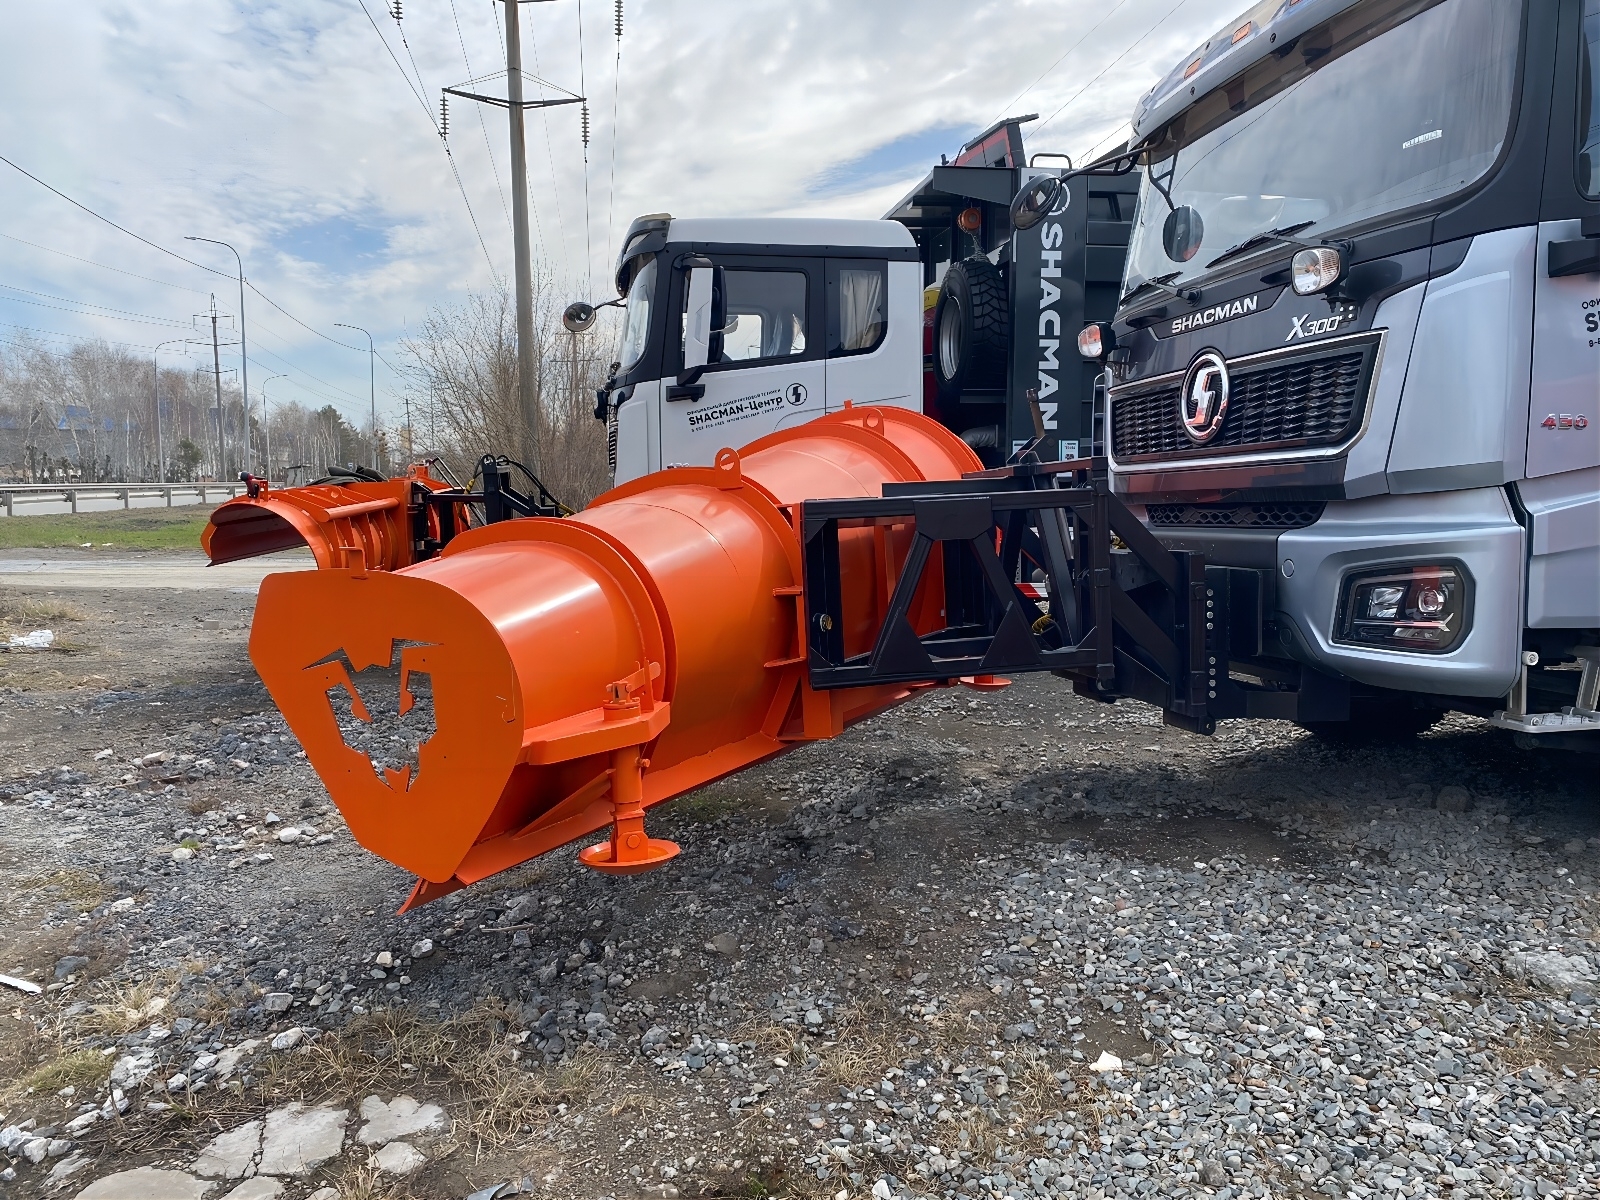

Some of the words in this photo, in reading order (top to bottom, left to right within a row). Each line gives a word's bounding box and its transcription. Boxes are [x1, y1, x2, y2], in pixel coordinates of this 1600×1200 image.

[1038, 221, 1063, 430] SHACMAN
[1171, 295, 1258, 334] SHACMAN
[1584, 310, 1600, 333] S
[688, 396, 783, 426] SHACMAN-Центр
